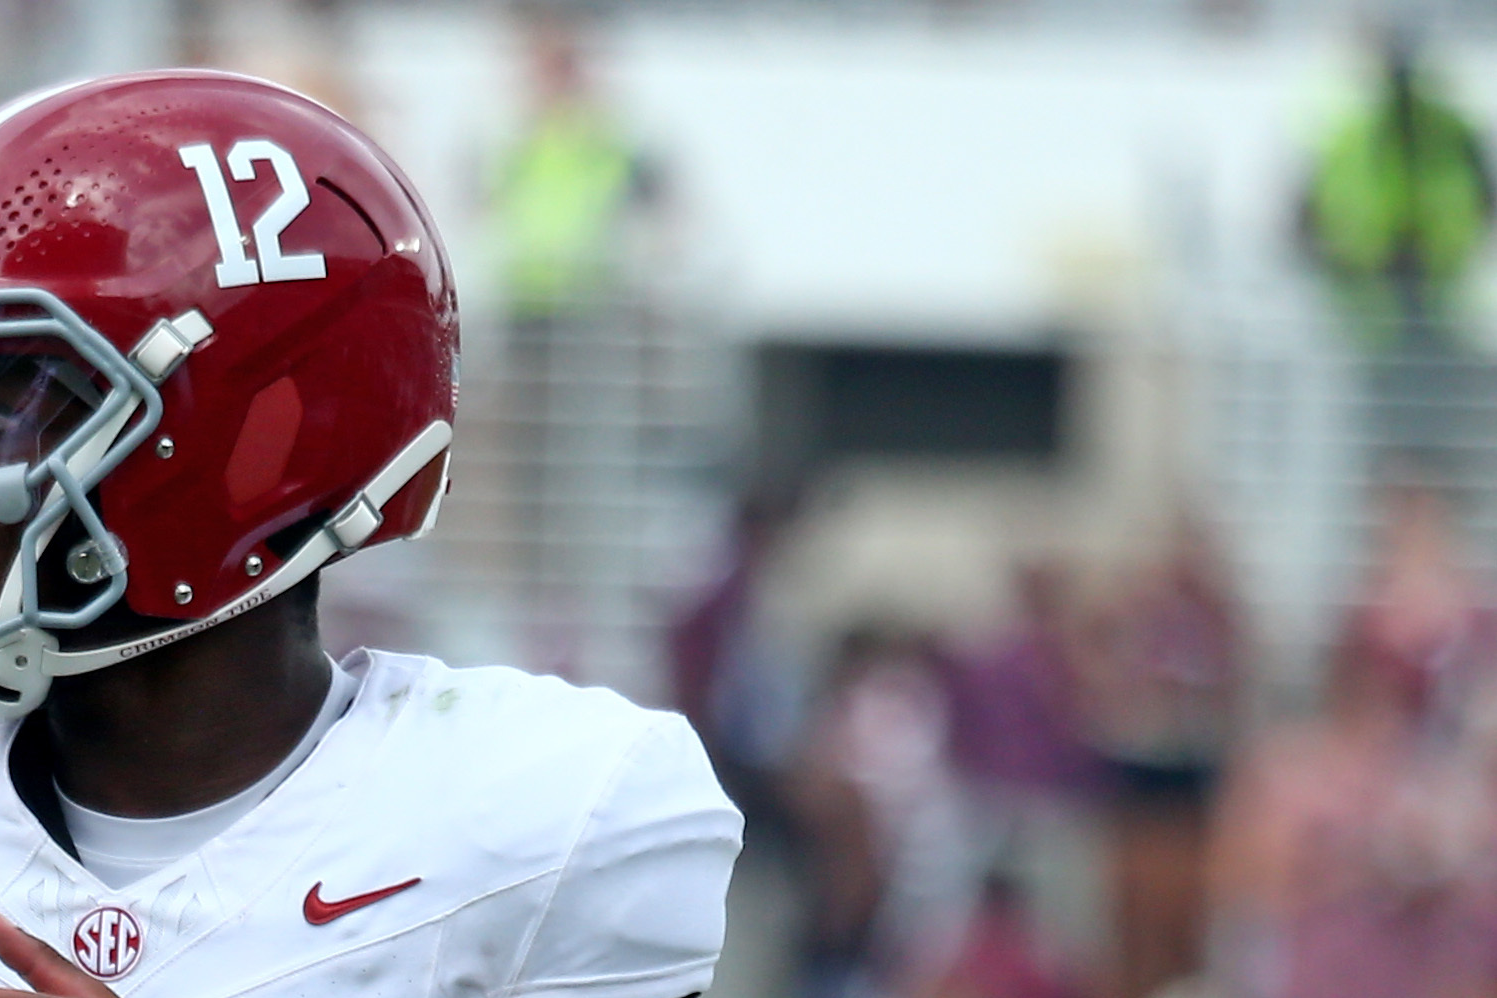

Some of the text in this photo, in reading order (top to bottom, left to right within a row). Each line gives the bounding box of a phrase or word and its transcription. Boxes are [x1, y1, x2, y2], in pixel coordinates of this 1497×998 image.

[178, 140, 327, 288] 12
[119, 587, 272, 657] CRIMSON TIDE
[76, 908, 138, 975] SEC
